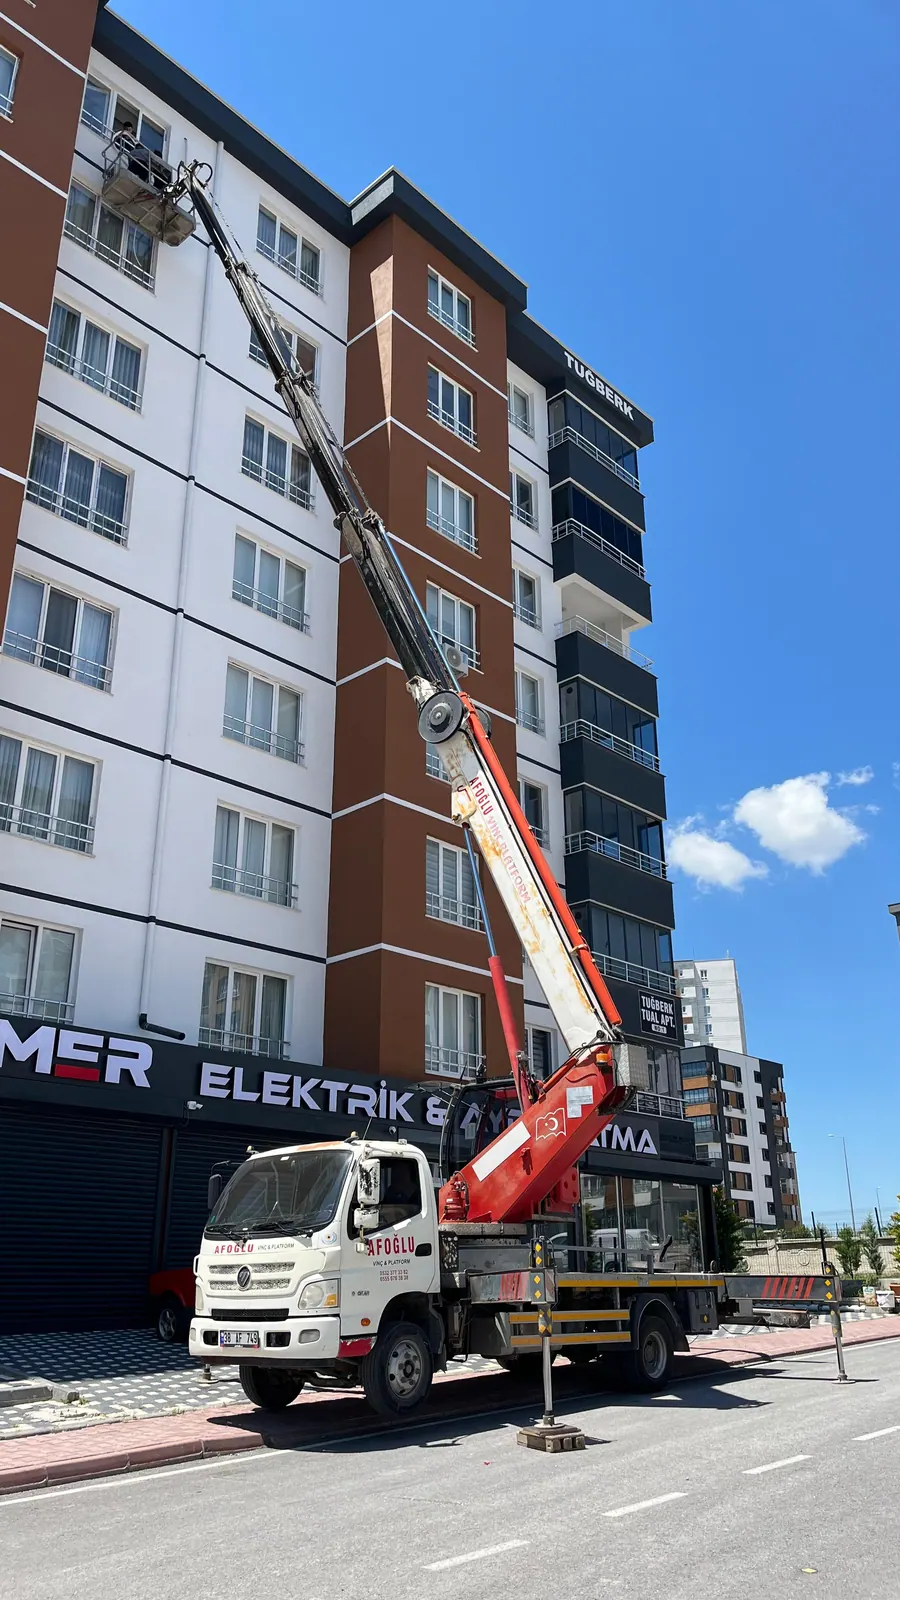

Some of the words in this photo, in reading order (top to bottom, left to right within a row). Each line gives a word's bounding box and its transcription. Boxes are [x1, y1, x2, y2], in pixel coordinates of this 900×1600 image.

[564, 351, 634, 421] TUĞBERK
[469, 776, 494, 816] AFOĞLU
[500, 842, 532, 904] PLATFORM
[641, 995, 674, 1015] TUĞBERK
[641, 1008, 660, 1024] TUAL
[660, 1013, 676, 1028] APT.
[200, 1062, 415, 1123] ELEKTRİK
[426, 1097, 448, 1126] &
[368, 1233, 415, 1256] AFOĞLU
[224, 1332, 231, 1343] 38
[235, 1332, 242, 1343] AF
[247, 1332, 258, 1344] 749
